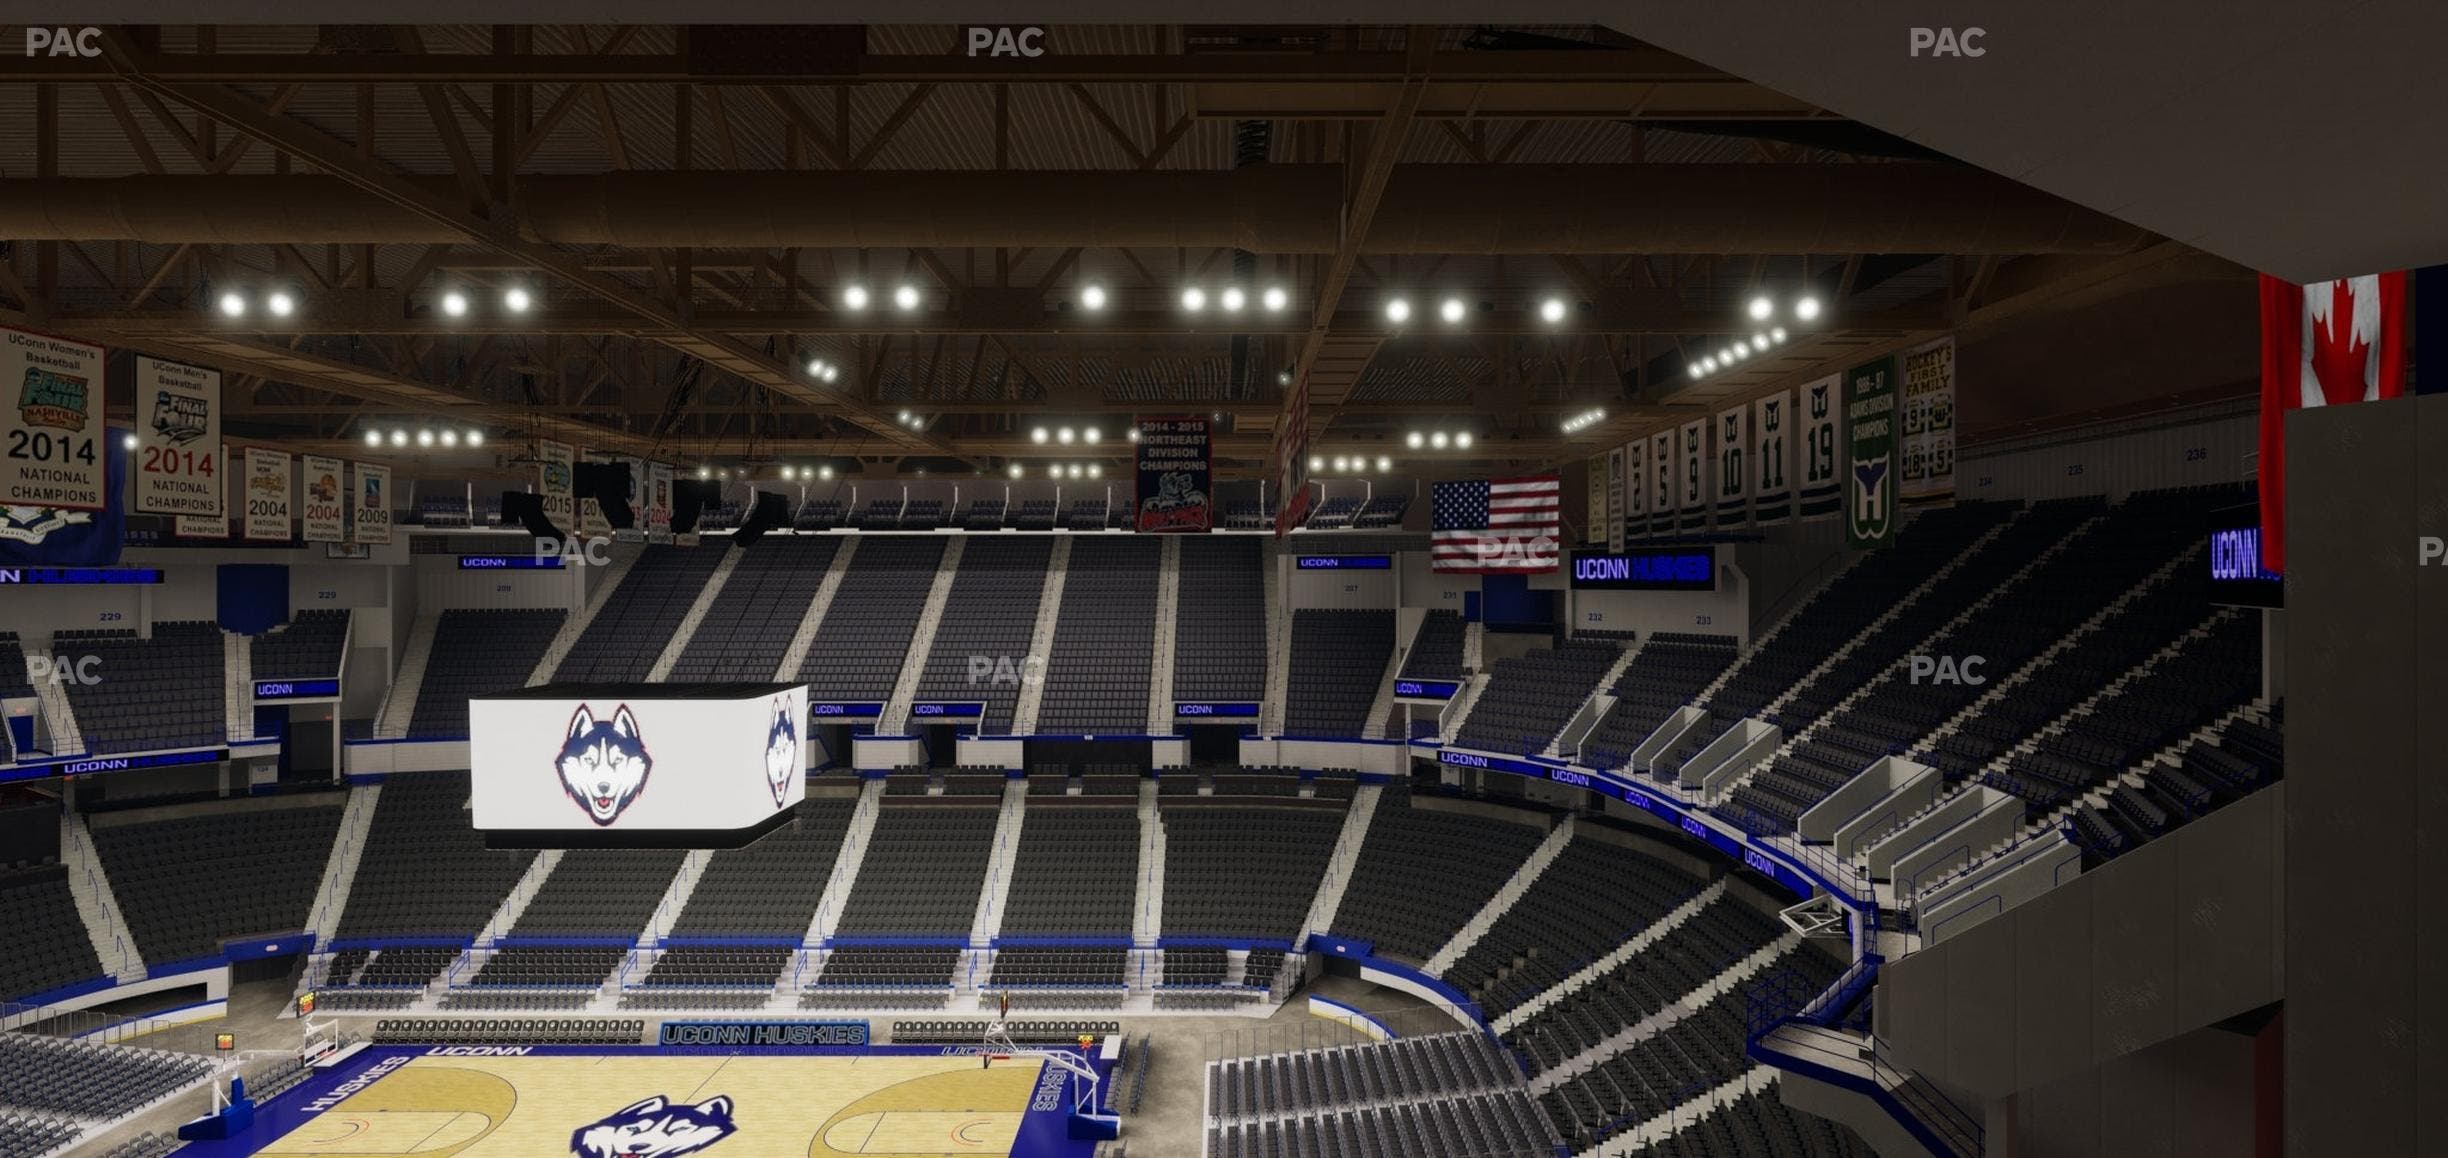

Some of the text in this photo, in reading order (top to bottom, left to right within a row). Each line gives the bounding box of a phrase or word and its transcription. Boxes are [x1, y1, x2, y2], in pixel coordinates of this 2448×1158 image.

[9, 334, 46, 349] UConn
[26, 351, 80, 369] Basketball
[153, 361, 182, 375] UConn
[1905, 375, 1950, 397] FAMILY
[8, 430, 96, 466] 2014
[1148, 448, 1199, 458] DIVISION
[1808, 422, 1833, 482] 19
[144, 446, 214, 477] 2014
[1140, 461, 1207, 471] CHAMPIONS
[1762, 436, 1783, 489] 11
[20, 467, 90, 484] NATIONAL
[1690, 457, 1697, 500] 9
[1723, 448, 1741, 496] 10
[153, 480, 209, 494] NATIONAL
[1660, 465, 1667, 506] 5
[11, 486, 96, 503] CHAMPIONS
[146, 496, 214, 511] CHAMPIONS
[250, 499, 287, 517] 2004
[543, 496, 571, 513] 2015
[307, 504, 340, 521] 2004
[357, 508, 388, 524] 2009
[2212, 528, 2257, 579] UCONN
[463, 558, 507, 567] UCONN
[1300, 558, 1338, 567] UCONN
[1576, 558, 1629, 580] UCONN
[100, 613, 121, 621] 229
[258, 684, 293, 695] UCONN
[1396, 683, 1422, 695] UCONN
[815, 705, 844, 714] UCONN
[915, 705, 944, 714] UCONN
[1178, 704, 1212, 714] UCONN
[64, 759, 128, 774] UCONN
[1441, 752, 1488, 767] UCONN
[1552, 769, 1589, 786] UCONN
[1681, 816, 1706, 838] UCONN
[1744, 849, 1775, 877] UCONN
[662, 1025, 866, 1044] UCONN HUSKIES
[425, 1046, 533, 1056] UCONN
[300, 1056, 410, 1112] HUSKIES
